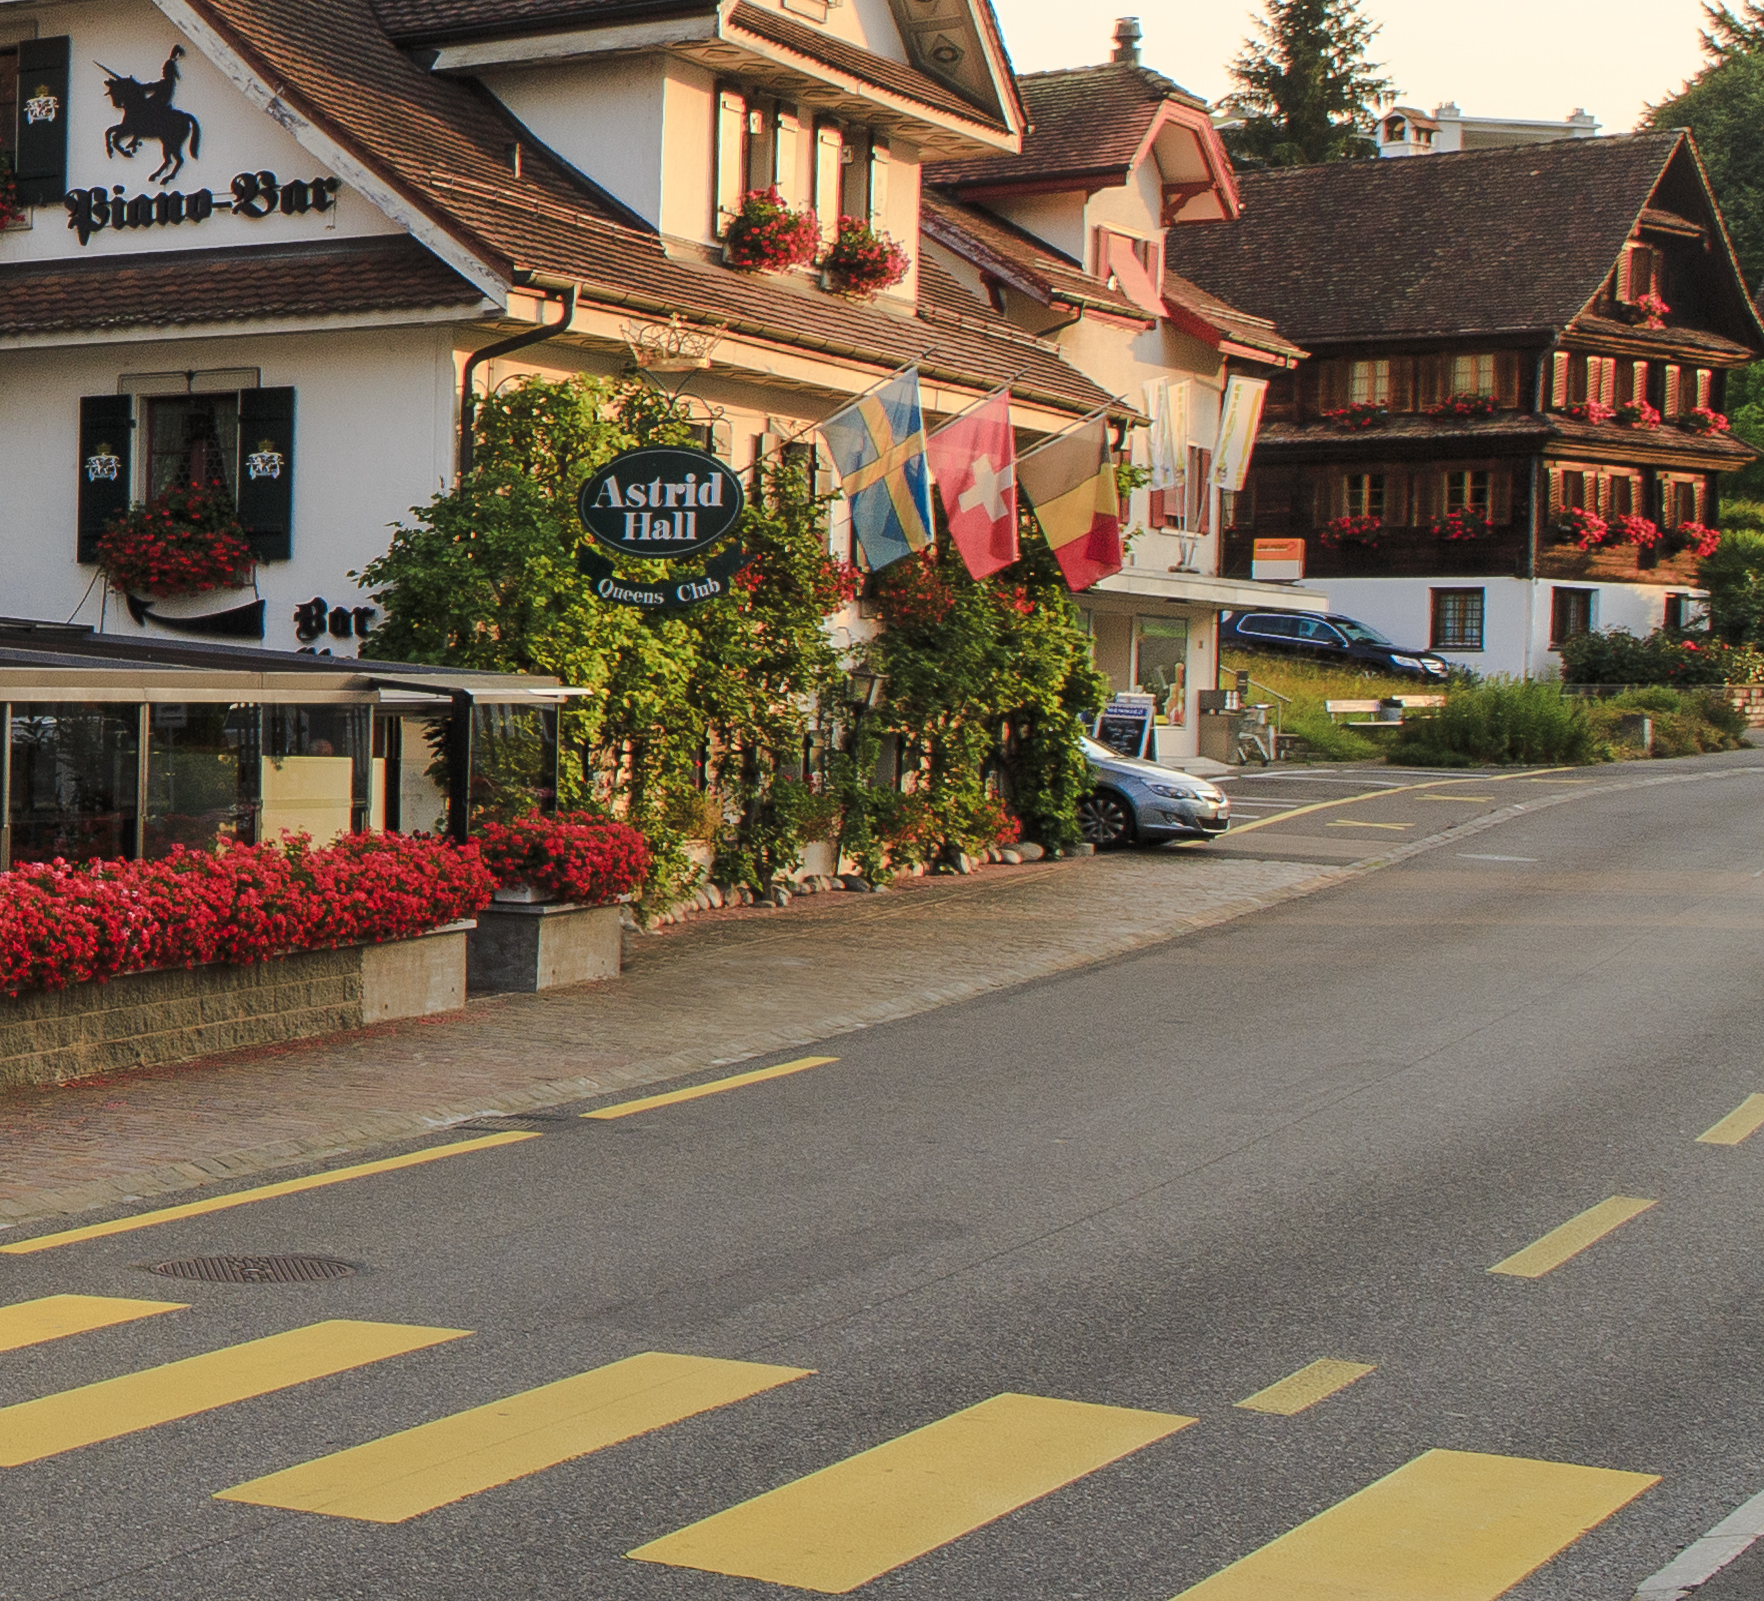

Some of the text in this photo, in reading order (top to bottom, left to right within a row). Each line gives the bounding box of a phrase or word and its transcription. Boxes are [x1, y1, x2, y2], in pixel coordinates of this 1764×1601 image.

[64, 169, 340, 247] Piano-Bar
[590, 471, 724, 509] Astrid
[621, 511, 698, 541] Hall
[596, 577, 721, 605] Queens Club
[293, 595, 377, 642] Bar
